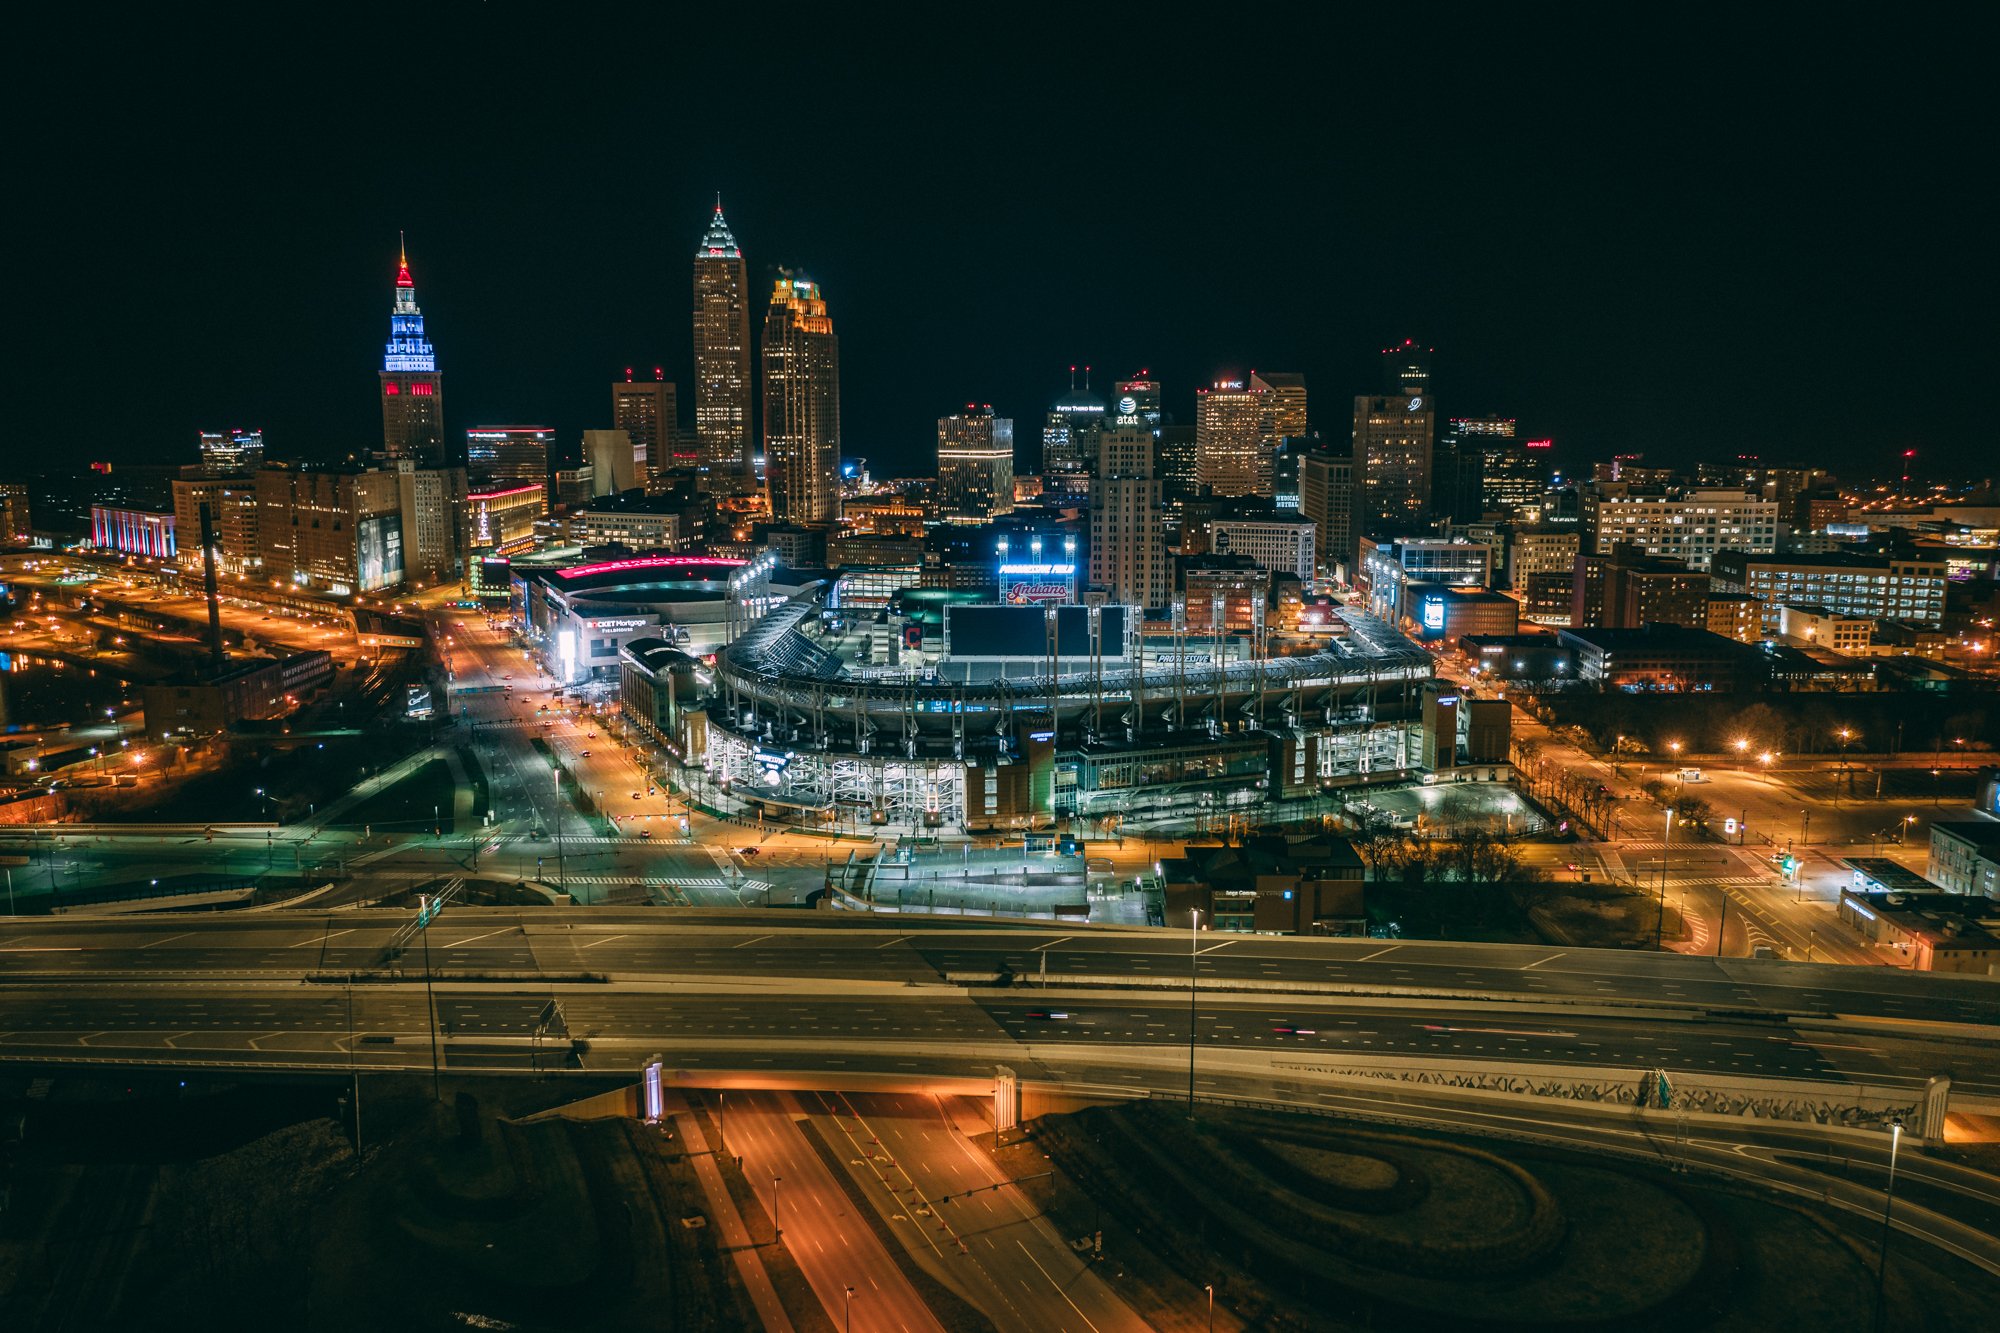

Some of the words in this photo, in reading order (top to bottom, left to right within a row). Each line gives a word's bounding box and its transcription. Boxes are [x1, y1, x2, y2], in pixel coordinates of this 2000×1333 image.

[1228, 381, 1242, 389] PNC
[1116, 414, 1139, 425] at&t
[1007, 582, 1067, 602] Indians
[586, 619, 615, 628] ROCKET
[616, 619, 646, 627] Mortgage
[906, 627, 920, 648] C
[754, 753, 787, 766] PROGRESSIVE
